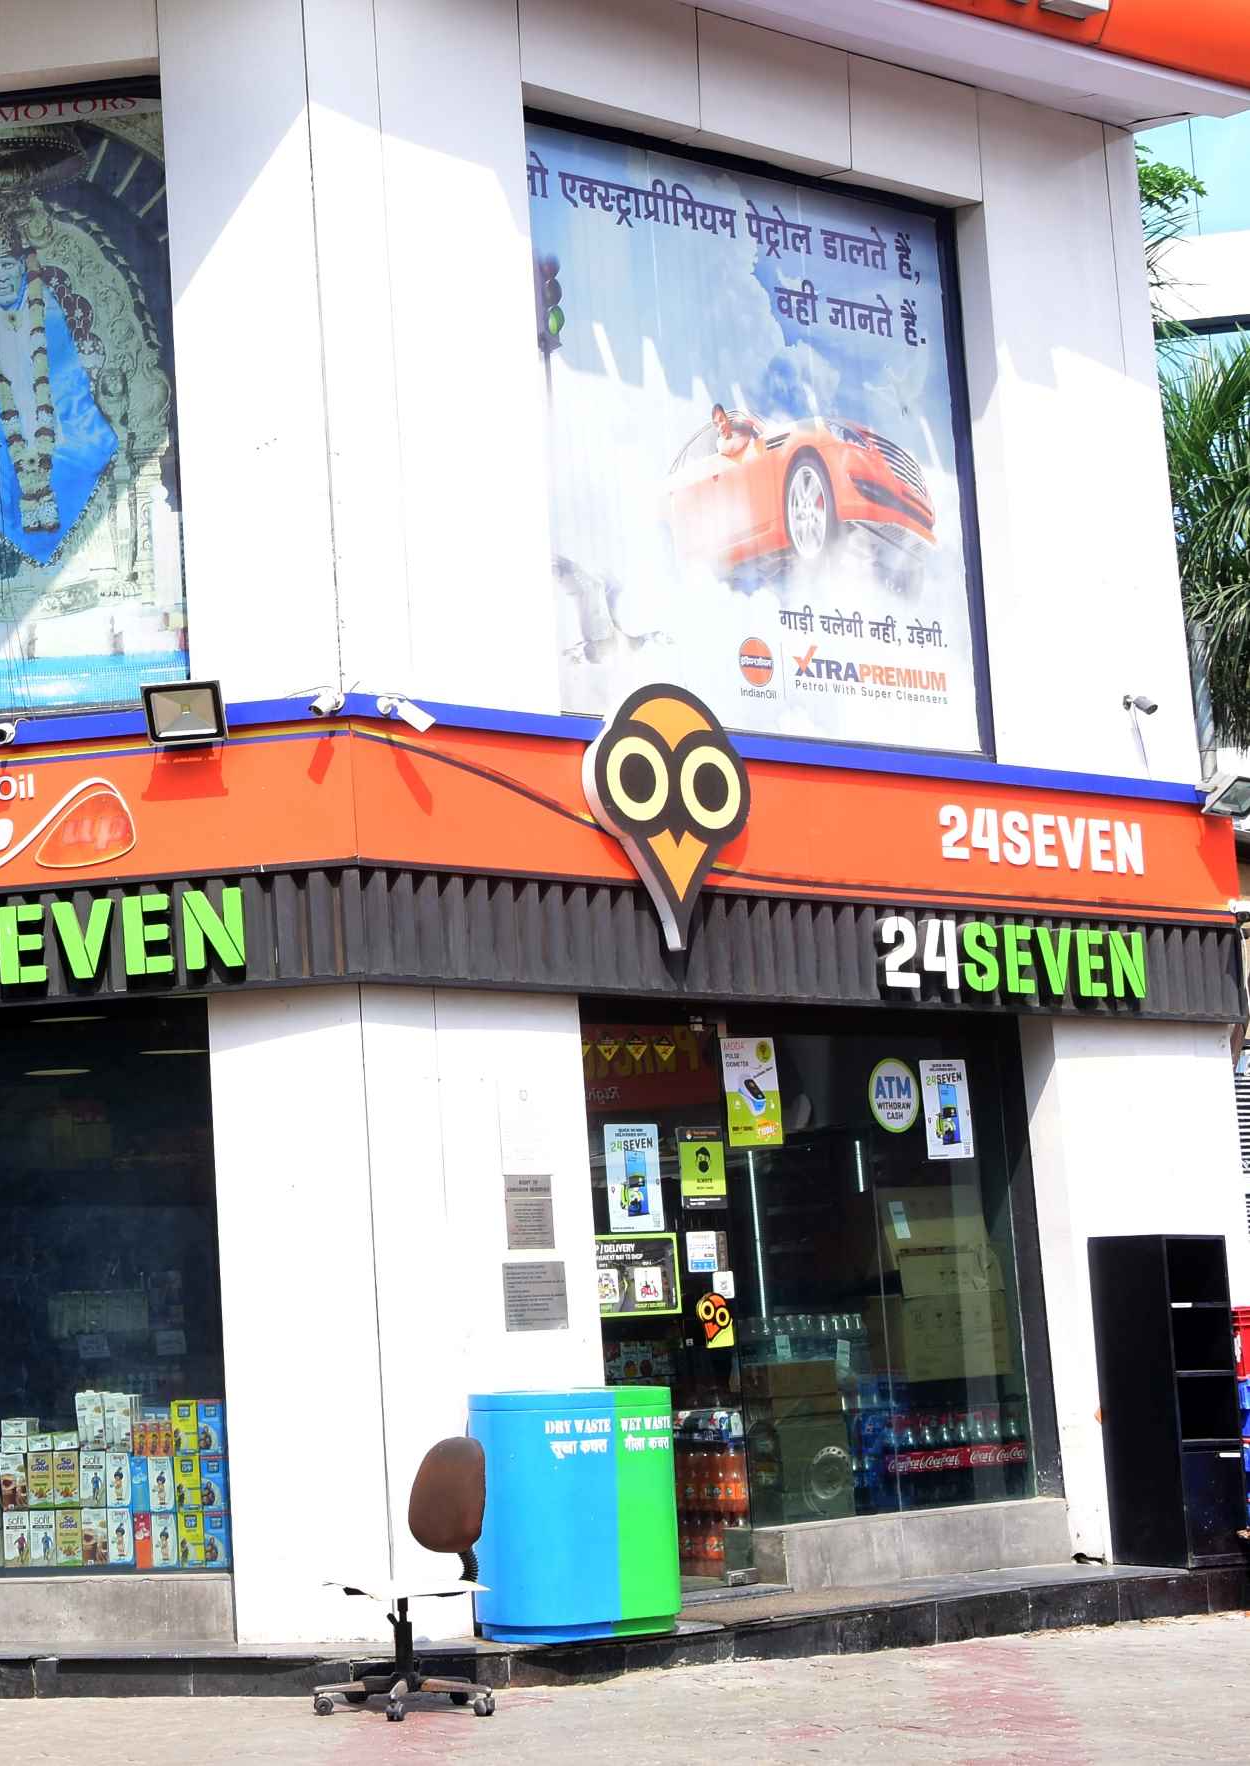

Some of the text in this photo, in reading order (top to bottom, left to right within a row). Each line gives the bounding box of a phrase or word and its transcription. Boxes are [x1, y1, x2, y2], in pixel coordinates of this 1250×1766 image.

[745, 201, 812, 259] पेट्रोल
[820, 226, 887, 271] डालते
[894, 232, 921, 285] हैं,
[774, 280, 819, 327] वही
[826, 294, 892, 338] जानते
[778, 604, 814, 635] गाड़ी
[819, 608, 864, 639] चलेगी
[792, 644, 947, 692] XTRAPREMIUM
[740, 687, 777, 700] IndianOil
[795, 679, 948, 705] Petrol With Super Cleansers
[939, 804, 1145, 876] 24SEVEN
[881, 916, 1146, 998] 24SEVEN
[875, 1076, 911, 1099] ATM
[877, 1102, 911, 1111] WITHDRAW
[886, 1112, 904, 1120] CASH
[604, 1243, 636, 1254] DELIVERY
[544, 1418, 611, 1434] DRY WASTE
[621, 1417, 642, 1432] WET
